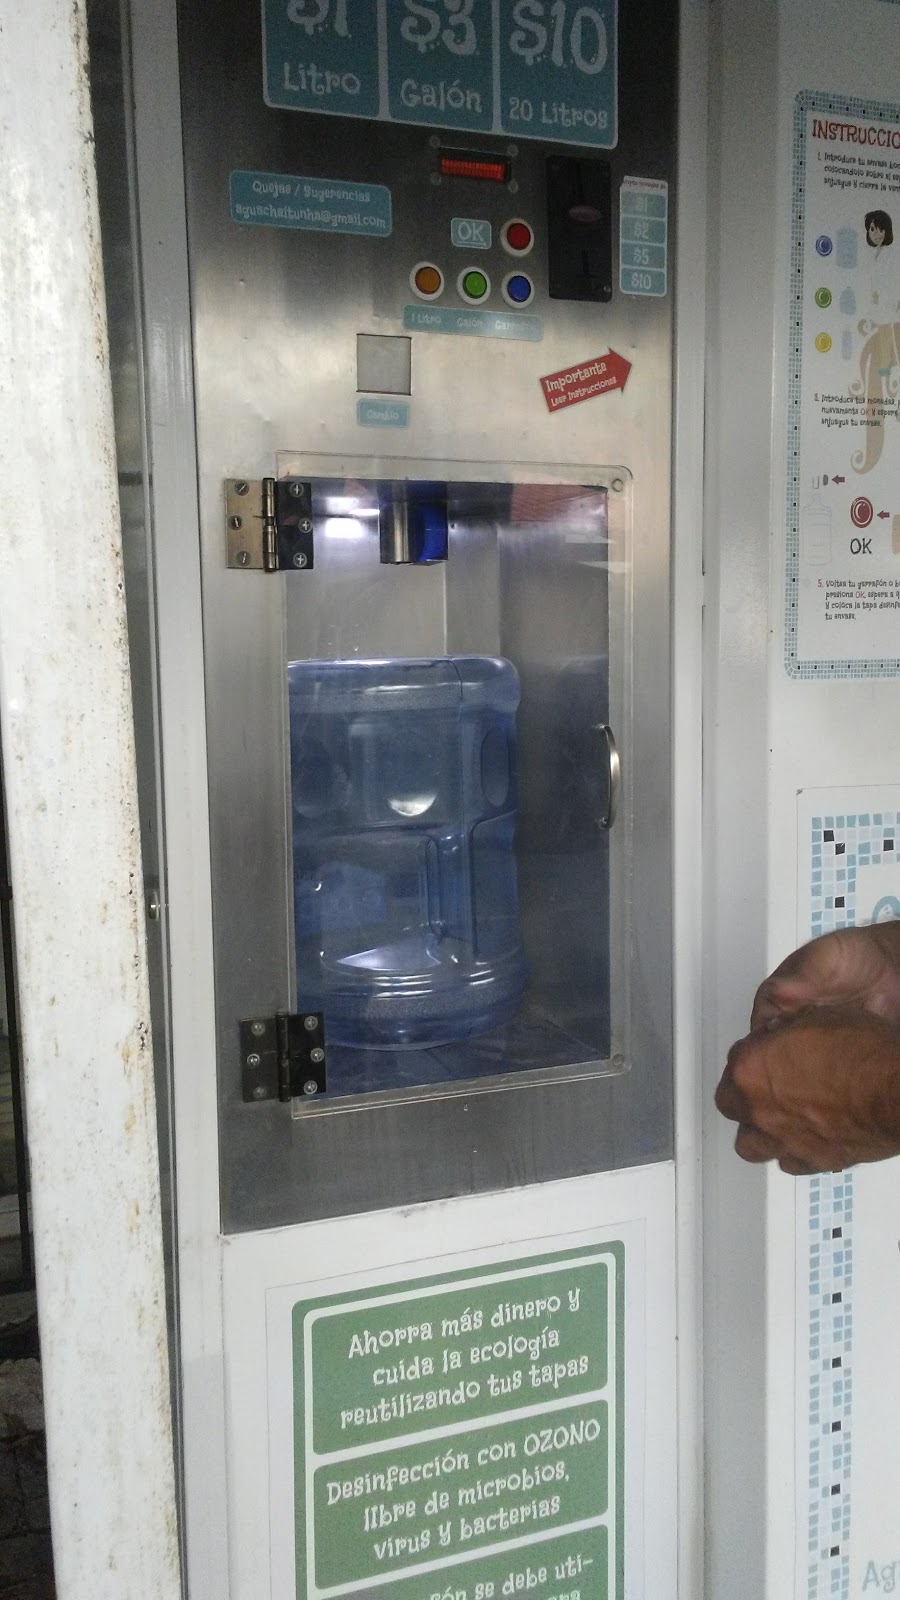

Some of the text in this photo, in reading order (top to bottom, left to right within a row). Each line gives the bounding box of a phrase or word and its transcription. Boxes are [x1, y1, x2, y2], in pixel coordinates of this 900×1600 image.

[509, 0, 608, 75] $10
[282, 62, 361, 95] Litro
[400, 80, 483, 113] Galón
[509, 97, 609, 129] 20 Litros
[252, 180, 291, 199] Quejas
[303, 185, 371, 203] Sugerencias
[458, 221, 485, 242] OK
[630, 272, 652, 290] $10
[545, 362, 607, 392] Importante
[551, 376, 617, 407] Leer Instrucciones
[850, 537, 873, 555] OK
[817, 579, 824, 588] 5.
[348, 1287, 581, 1359] Ahorra más dinero y
[373, 1326, 561, 1386] cuida la ecología
[340, 1355, 590, 1430] reutilizando tus tapas
[326, 1418, 602, 1506] Desinfección con OZONO
[363, 1460, 571, 1532] libre de microbios,
[373, 1494, 562, 1561] virus y bacterias
[474, 1581, 494, 1600] se
[502, 1566, 547, 1596] debe
[555, 1553, 594, 1580] uti-
